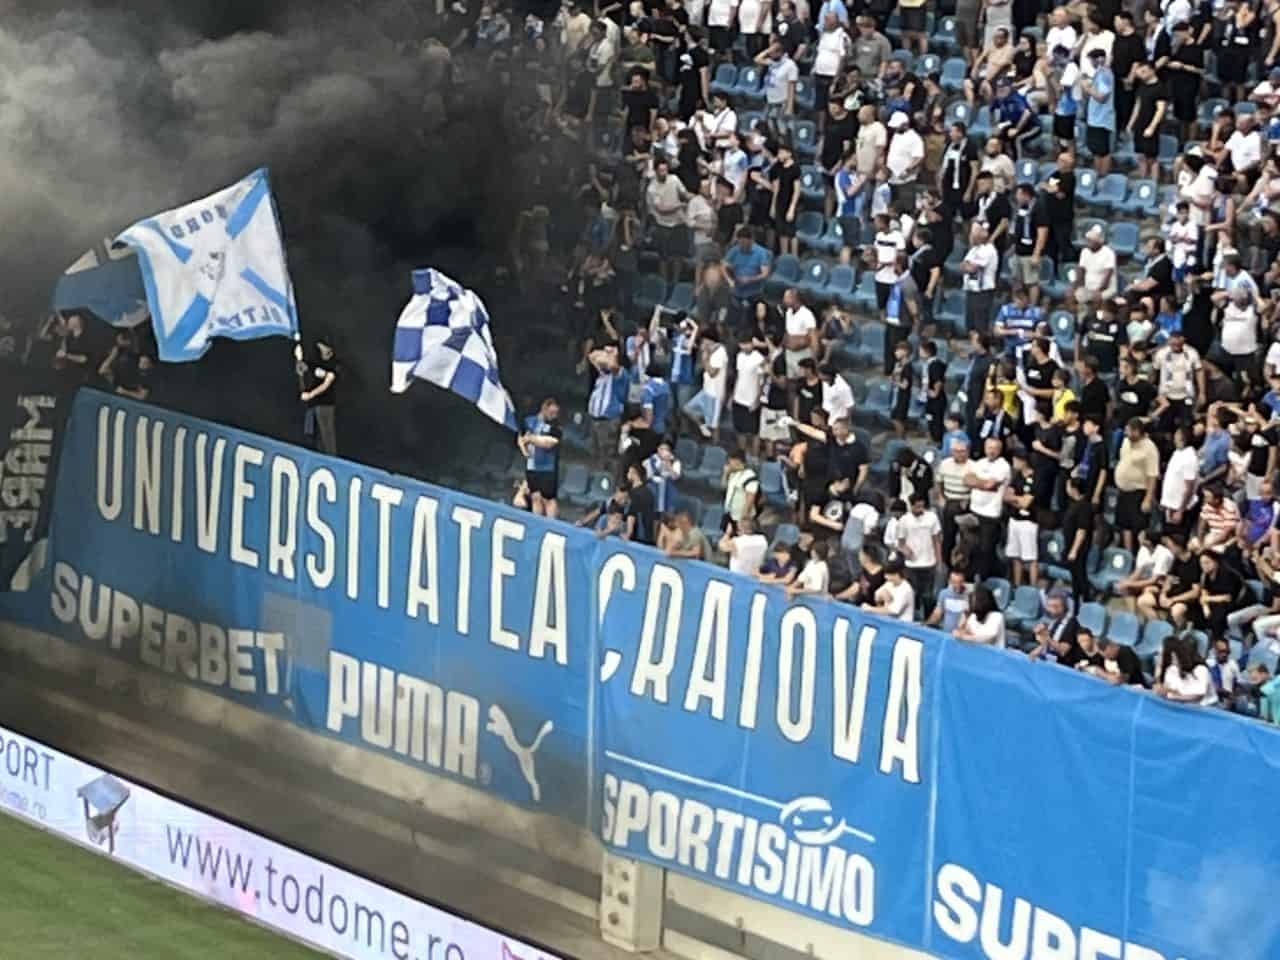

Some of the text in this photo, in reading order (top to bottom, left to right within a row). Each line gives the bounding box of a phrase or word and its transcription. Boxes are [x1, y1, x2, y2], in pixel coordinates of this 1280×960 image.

[50, 561, 285, 695] SUPERBET
[95, 404, 924, 784] UNIVERSITATEA CRAIOVA
[326, 650, 481, 780] PUMA
[602, 775, 875, 927] SPORTISIMO
[933, 863, 1187, 960] SUP
